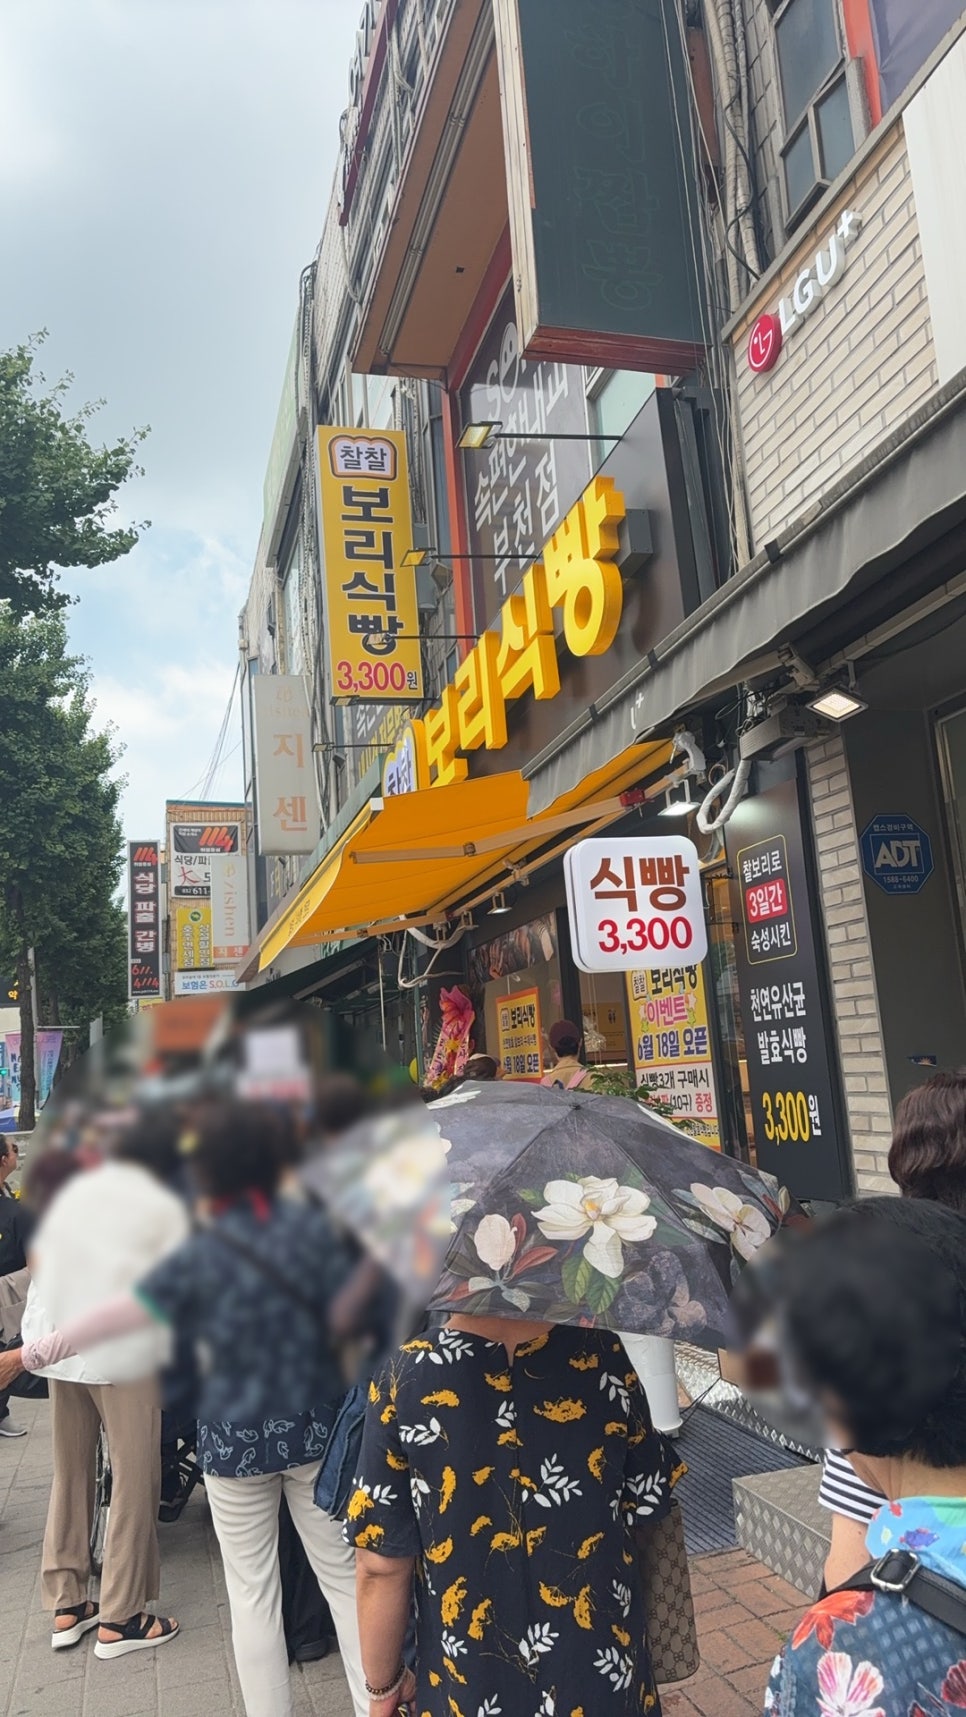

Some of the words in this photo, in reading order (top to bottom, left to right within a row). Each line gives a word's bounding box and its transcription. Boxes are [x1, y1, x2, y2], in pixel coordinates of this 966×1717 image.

[778, 209, 862, 336] LGU+
[340, 445, 388, 472] 찰찰
[494, 439, 560, 596] 부천점
[341, 485, 404, 656] 보리식빵
[424, 477, 626, 788] 보리식빵
[337, 660, 418, 693] 3,300원
[743, 850, 782, 883] 찰보리로
[874, 840, 921, 868] ADT
[590, 855, 690, 912] 식빵
[748, 882, 784, 917] 3일간
[598, 916, 693, 955] 3,300
[751, 929, 791, 953] 숙성시킨
[511, 1004, 536, 1030] 보리식빵
[647, 996, 688, 1028] 이벤트
[751, 982, 806, 1022] 천연유산균
[656, 1030, 680, 1058] 18일
[683, 1026, 707, 1056] 오픈
[757, 1026, 807, 1064] 발효식빵
[527, 1053, 539, 1073] 오픈
[677, 1068, 709, 1089] 구매시
[695, 1092, 712, 1112] 증정
[762, 1090, 822, 1147] 3,300원
